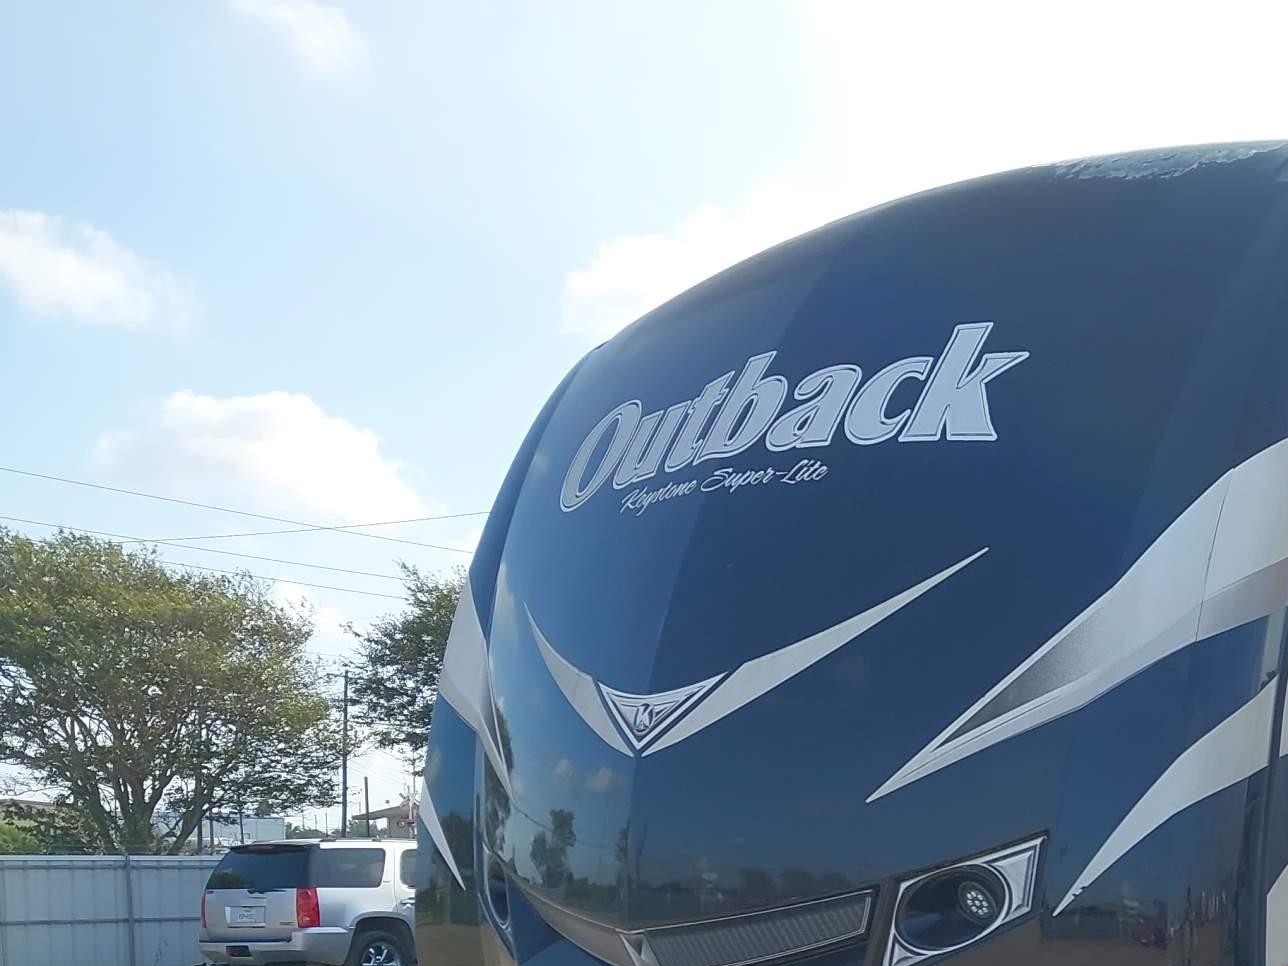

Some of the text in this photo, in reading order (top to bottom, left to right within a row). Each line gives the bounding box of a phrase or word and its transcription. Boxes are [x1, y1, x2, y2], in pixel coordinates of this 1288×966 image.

[560, 321, 1030, 512] Outback
[619, 459, 829, 516] Keystone Super-Lite
